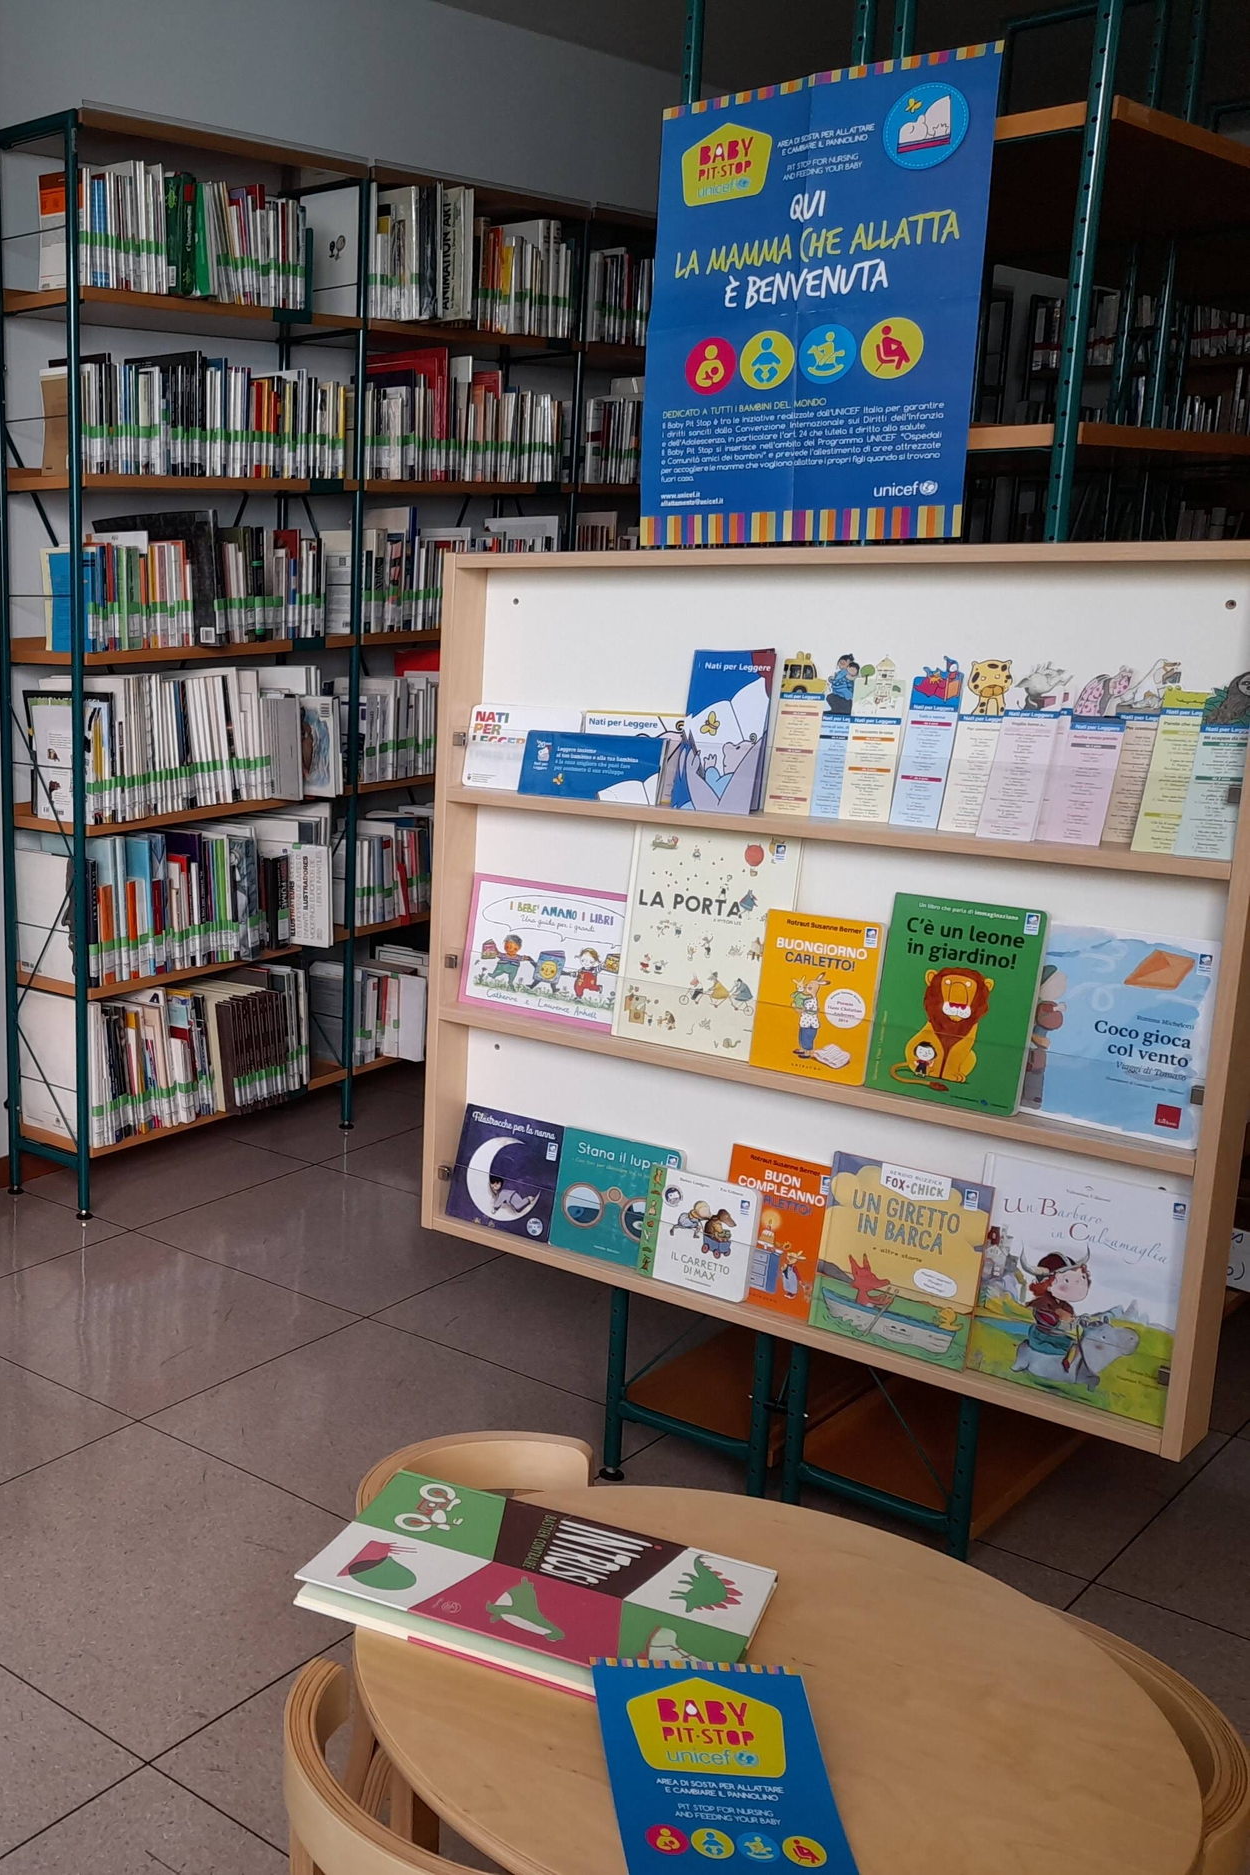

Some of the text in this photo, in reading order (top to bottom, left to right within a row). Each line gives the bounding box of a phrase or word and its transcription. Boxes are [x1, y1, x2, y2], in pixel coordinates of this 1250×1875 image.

[777, 140, 793, 149] AREA
[801, 133, 820, 144] SOSTA
[820, 130, 834, 140] PER
[835, 123, 876, 137] ALLATTARE
[781, 134, 868, 157] E CAMBIARE IL PANNOLINO
[699, 136, 753, 167] BABY
[787, 153, 859, 172] PIT STOP FOR NURSING
[782, 161, 863, 182] AND FEEDING YOUR BABY
[697, 180, 735, 199] unicef
[789, 190, 826, 223] QUI
[675, 209, 960, 280] LA MAMMA CHE ALLATTA
[442, 202, 452, 311] ANIMATION ART
[725, 258, 889, 310] È BENVENUTA
[663, 408, 700, 420] DEDICATO
[701, 407, 708, 416] A
[710, 405, 733, 415] TUTTI
[738, 402, 772, 414] BAMBINI
[773, 401, 790, 410] DEL
[793, 397, 827, 408] MONDO
[735, 423, 786, 434] Convenzione
[660, 491, 700, 500] www.unicef.it
[873, 481, 920, 498] unicef
[705, 661, 771, 673] Nati per Leggere
[475, 711, 510, 724] NATI
[588, 718, 658, 729] Nati per Leggere
[472, 722, 502, 736] PER
[638, 889, 742, 919] LA PORTA
[951, 906, 967, 914] parla
[541, 906, 577, 921] AMANO
[590, 913, 614, 926] LIBRI
[786, 918, 862, 935] Rotraut Susanne Berner
[906, 916, 1025, 949] C'è un leone
[776, 936, 868, 960] BUONGIORNO
[906, 937, 1018, 970] in giardino!
[785, 951, 856, 972] CARLETTO!
[1094, 1020, 1191, 1050] Coco gioca
[1107, 1043, 1189, 1068] col vento
[1116, 1061, 1187, 1082] Viaggi di Tomaso
[472, 1110, 556, 1141] Filastrocche per la nanna
[577, 1141, 615, 1161] Stana
[619, 1152, 626, 1164] il
[764, 1169, 801, 1189] BUON
[772, 1159, 799, 1172] Susanne
[799, 1166, 821, 1177] Berner
[738, 1174, 825, 1207] COMPLEANNO
[852, 1188, 961, 1235] UN GIRETTO
[1003, 1197, 1104, 1225] Un Barbaro
[857, 1212, 944, 1255] IN BARCA
[1051, 1222, 1168, 1266] in Calzamaglia
[670, 1251, 730, 1276] IL CARRETTO
[880, 1248, 899, 1257] altre
[901, 1252, 923, 1263] storie
[683, 1264, 716, 1282] DI MAX
[522, 1514, 557, 1570] BASTIEN CONTRAIRE
[657, 1698, 748, 1727] BABY
[666, 1748, 730, 1766] unicef
[656, 1778, 785, 1796] AREA DI SOSTA PER ALLATTARE
[664, 1786, 779, 1802] E CAMBIARE IL PANNOLINO
[674, 1811, 782, 1828] AND FEEDING YOUR BABY
[677, 1803, 774, 1818] PIT STOP FOR NURSING
